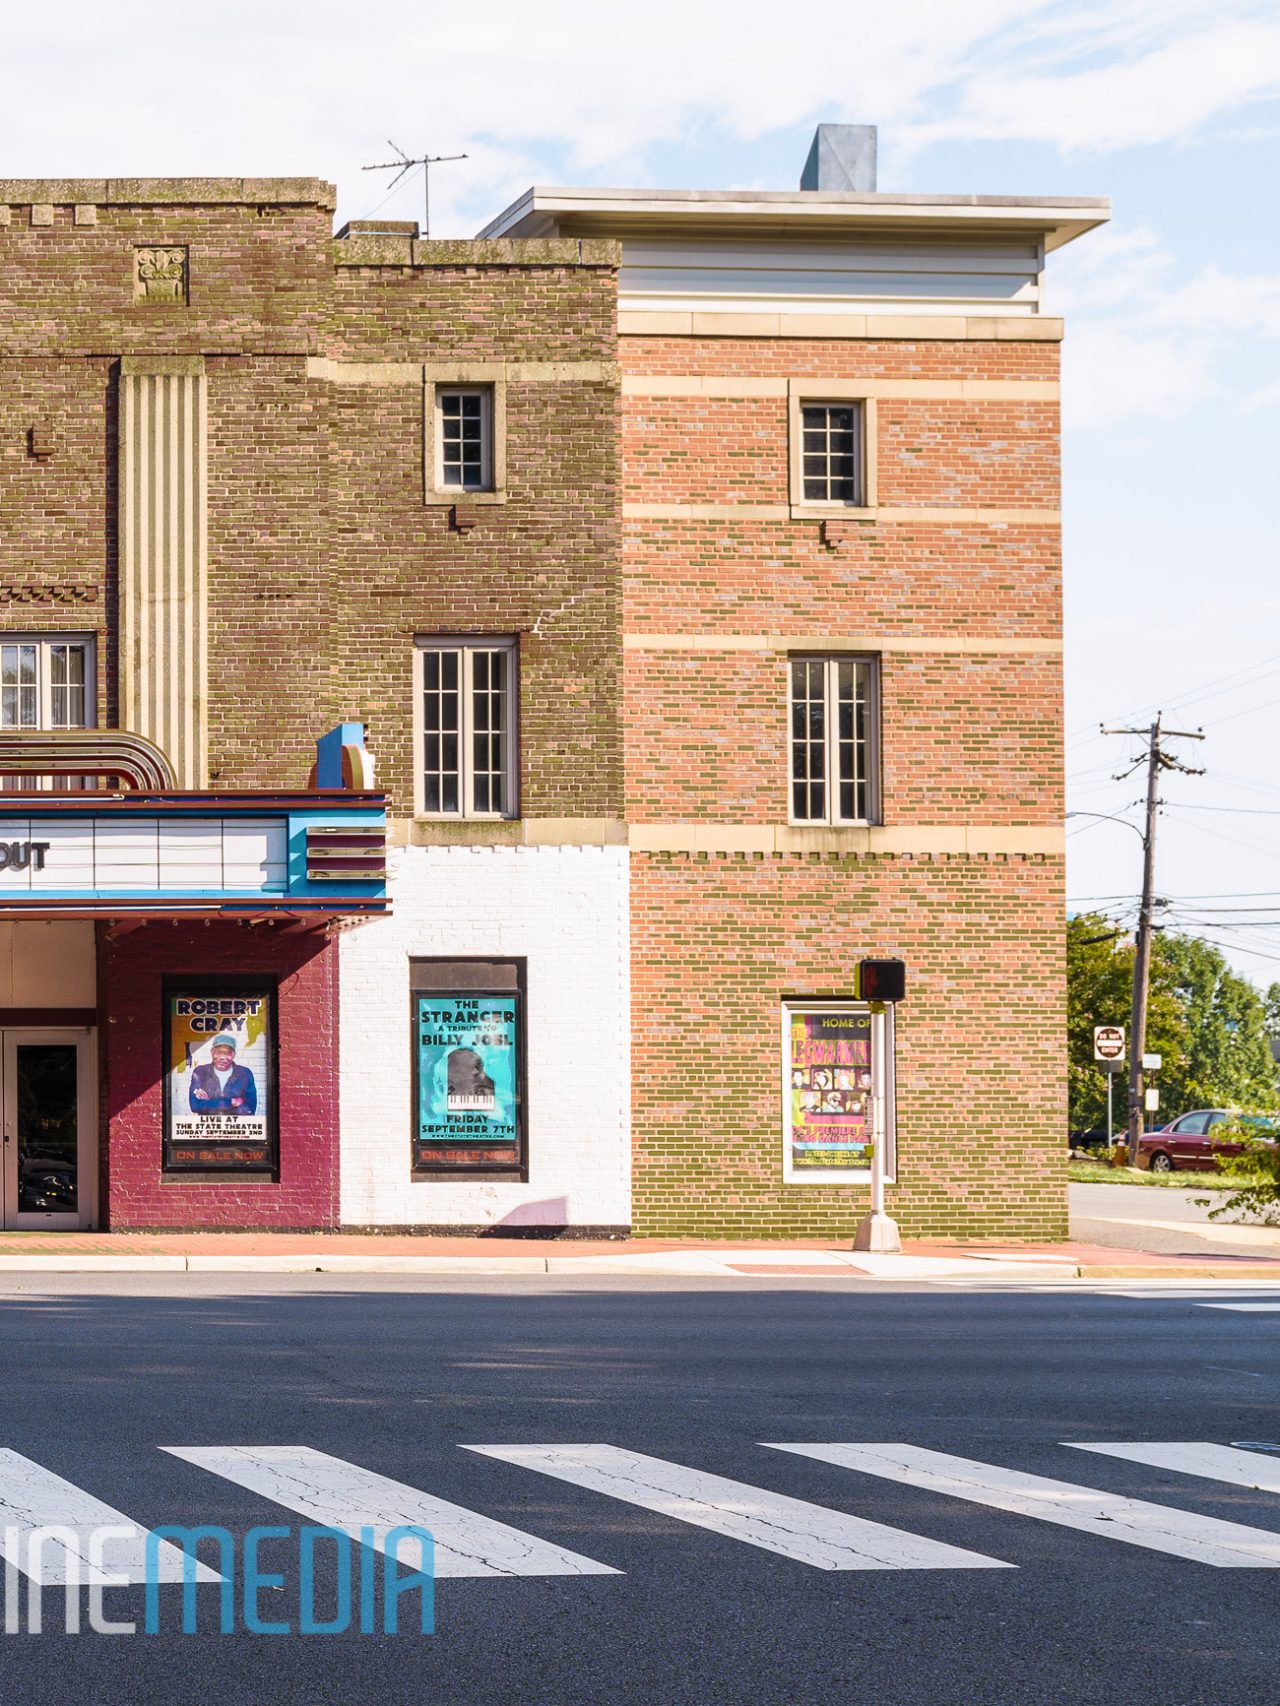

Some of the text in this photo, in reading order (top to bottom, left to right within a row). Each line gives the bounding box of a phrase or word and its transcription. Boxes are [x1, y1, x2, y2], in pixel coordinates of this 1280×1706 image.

[176, 999, 261, 1016] ROBERT
[454, 1001, 479, 1009] THE
[421, 1010, 515, 1023] STRANGER
[190, 1016, 248, 1033] CRAY
[822, 1018, 871, 1028] HOME OF
[422, 1034, 464, 1046] BILLY
[792, 1039, 871, 1064] LEGWARME
[447, 1114, 489, 1123] FRIDAY
[422, 1125, 515, 1133] SEPTEMBER 7TH
[176, 1151, 264, 1160] ON SALE NOW
[422, 1151, 516, 1160] ON SALE NOW
